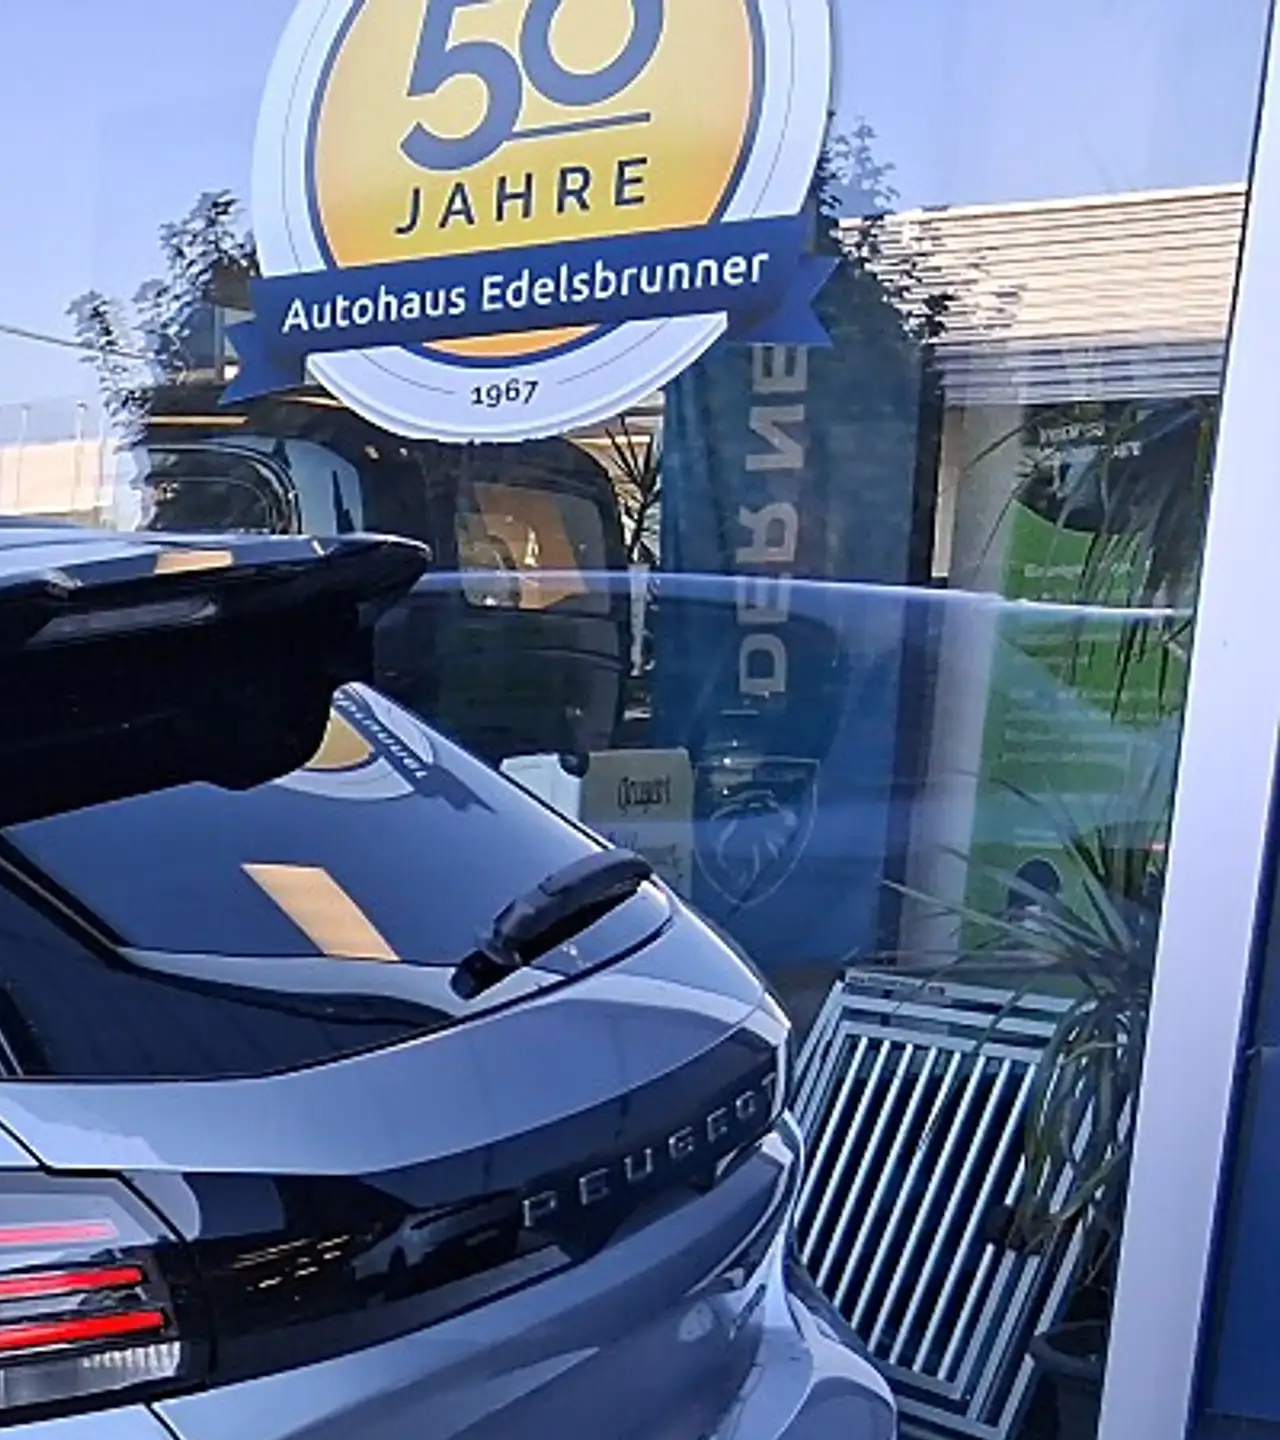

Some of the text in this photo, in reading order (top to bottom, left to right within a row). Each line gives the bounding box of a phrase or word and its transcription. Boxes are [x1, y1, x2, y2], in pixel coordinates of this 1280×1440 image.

[399, 0, 664, 171] 50
[393, 156, 648, 235] JAHRE
[281, 252, 770, 334] Autohaus Edelsbrunner
[470, 379, 539, 407] 1967
[522, 1072, 776, 1227] PEUGEOT
